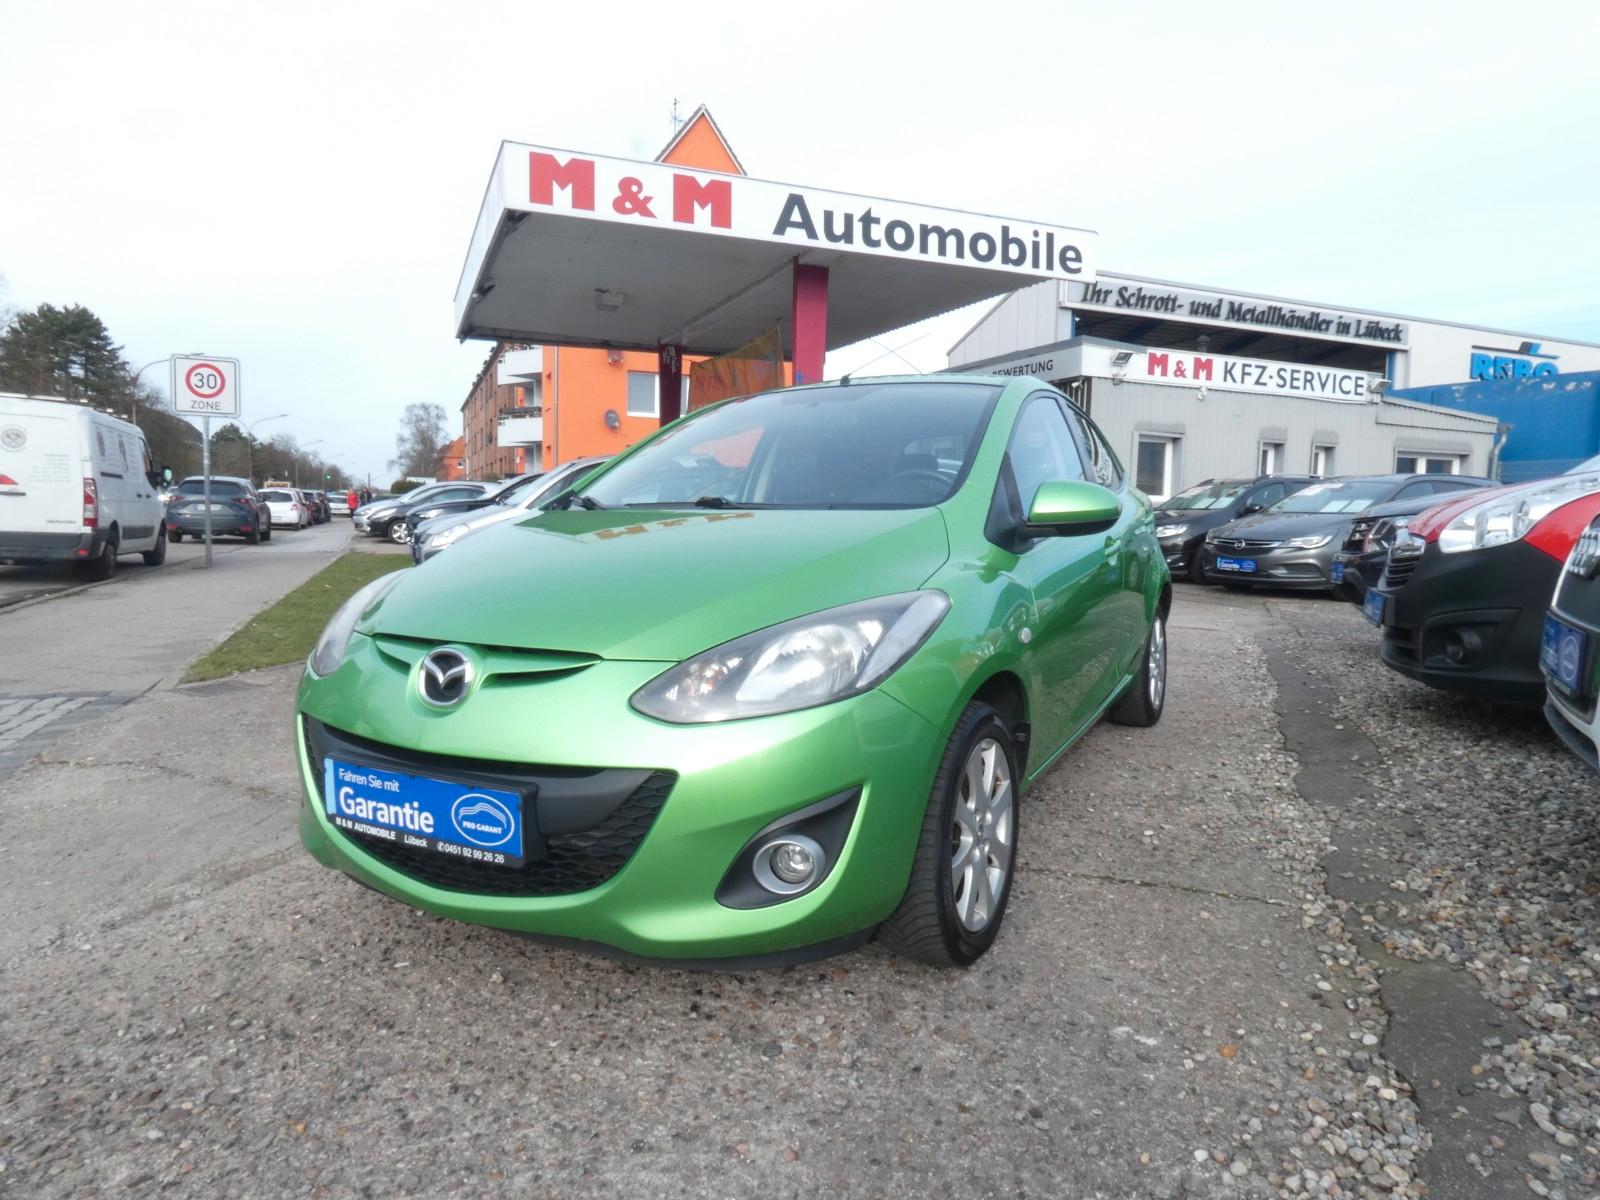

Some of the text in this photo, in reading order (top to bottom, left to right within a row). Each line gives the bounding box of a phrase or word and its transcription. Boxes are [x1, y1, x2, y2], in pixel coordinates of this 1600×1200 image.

[529, 151, 1083, 275] M & M Automobile
[1081, 281, 1403, 342] Ihr Schrott- und Metallhändler in Lübeck
[1148, 352, 1169, 378] M
[1173, 360, 1188, 379] &
[1192, 357, 1214, 381] M
[194, 372, 217, 390] 30
[191, 400, 222, 411] ZONE
[338, 768, 400, 793] Fahren Sie mit
[340, 786, 434, 834] Garantie
[354, 822, 396, 840] AUTOMOBILE
[404, 834, 428, 848] Lübeck
